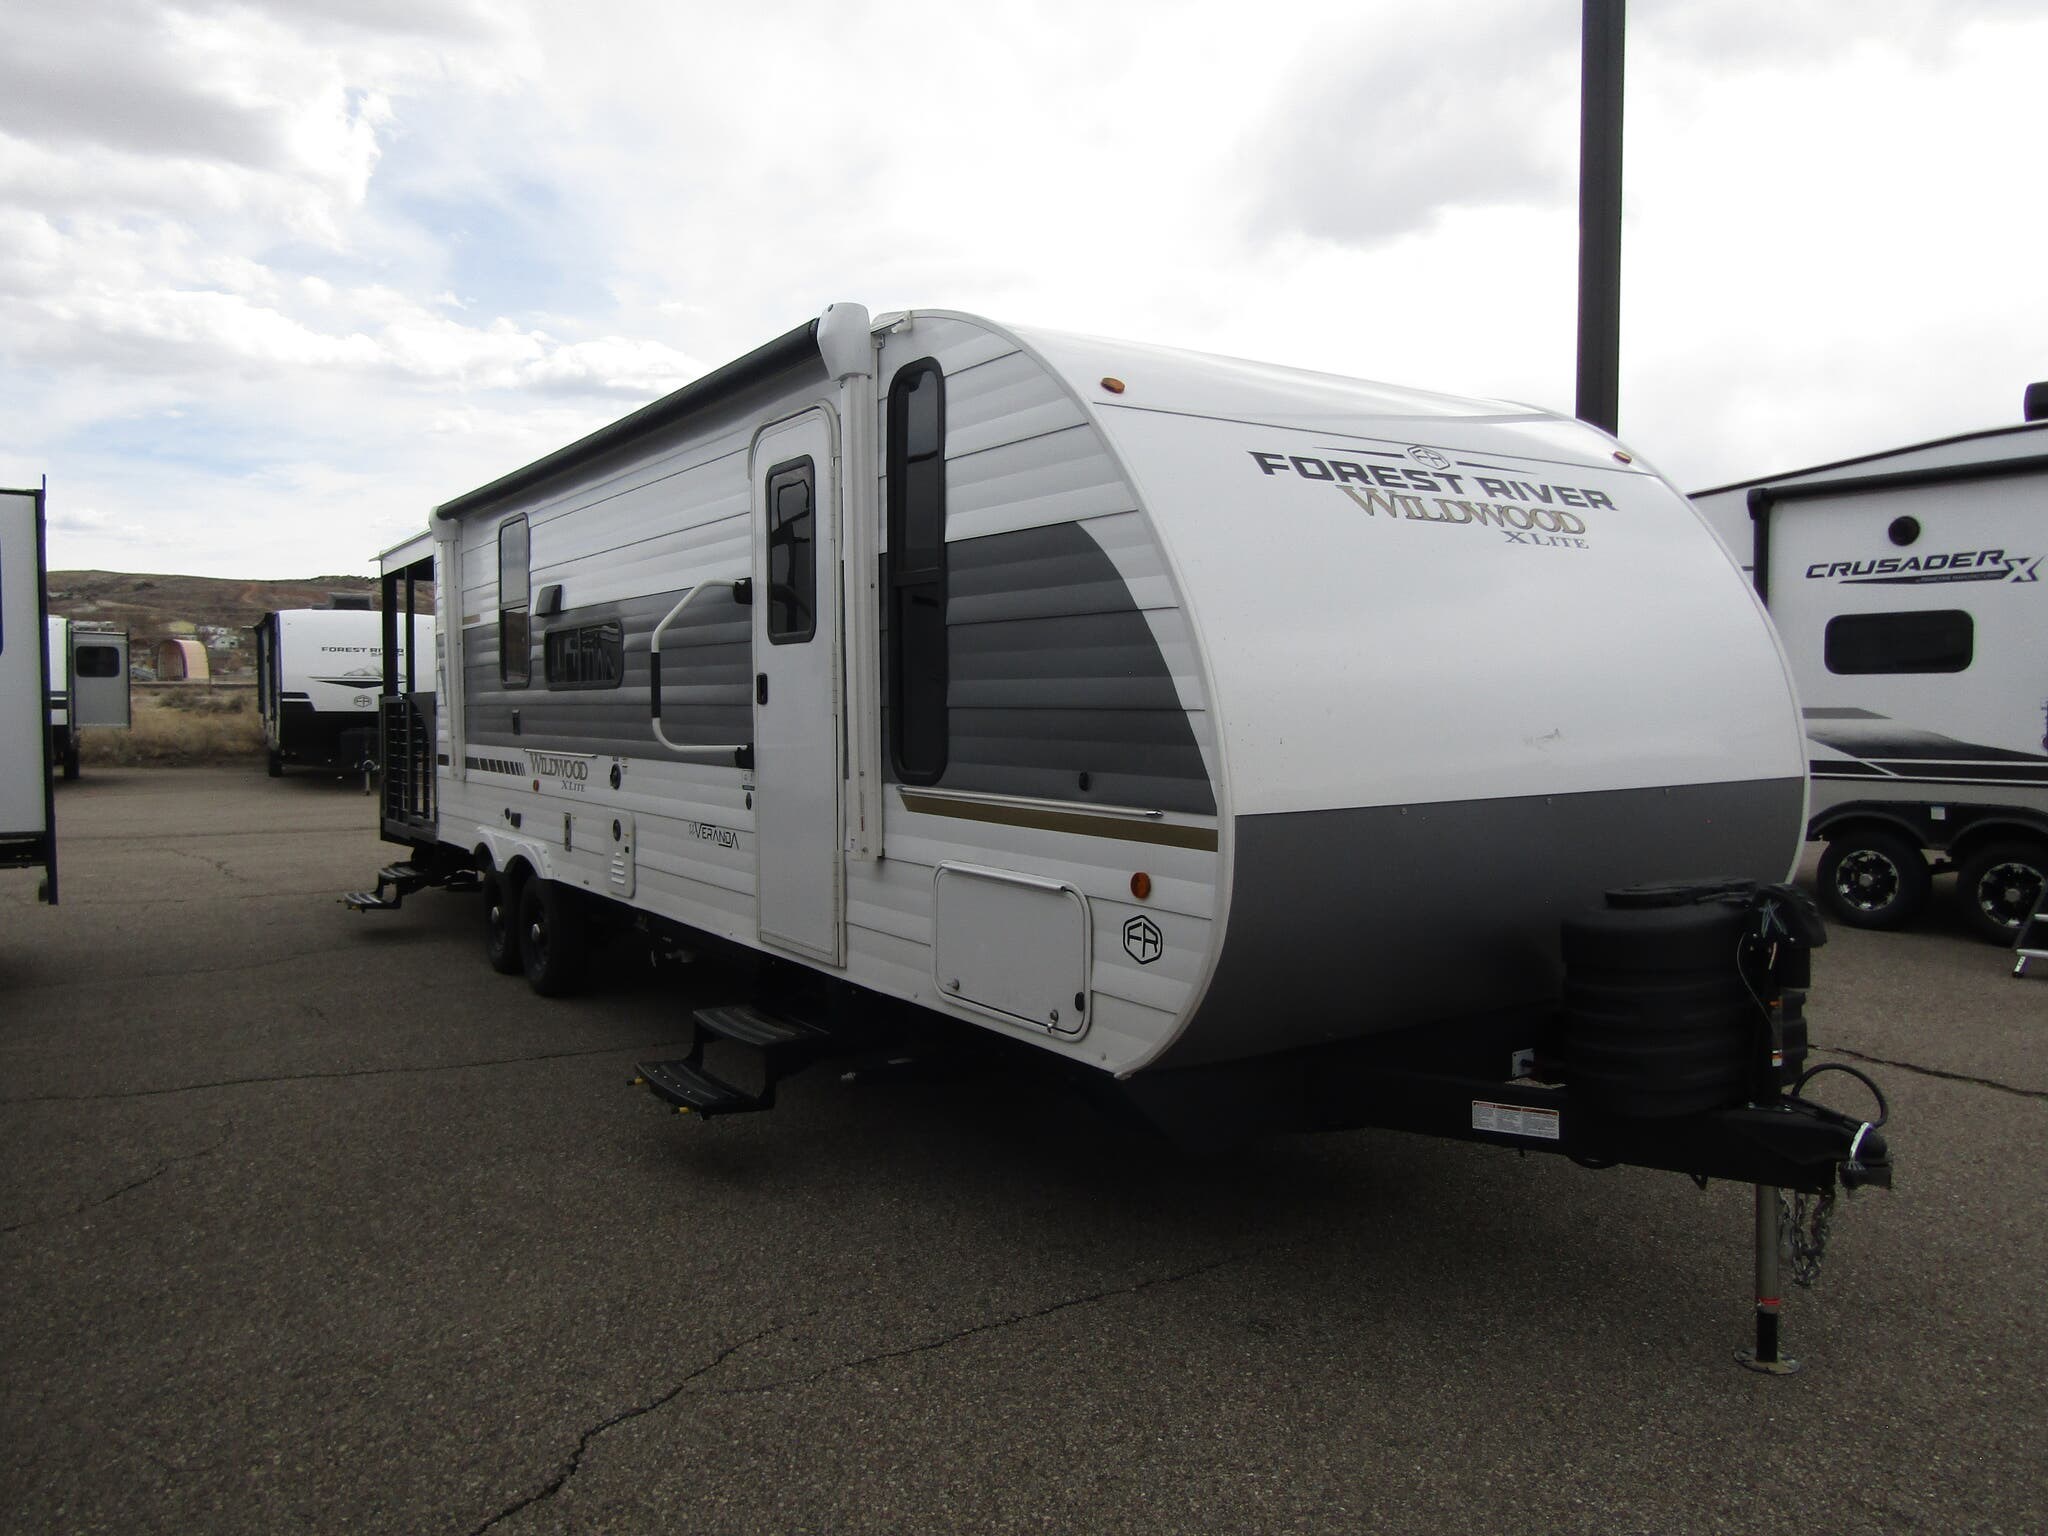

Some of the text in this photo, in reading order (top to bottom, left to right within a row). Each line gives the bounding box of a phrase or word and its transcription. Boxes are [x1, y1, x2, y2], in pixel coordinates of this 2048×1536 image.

[1247, 450, 1619, 511] FOREST RIVER
[1335, 484, 1586, 534] WILDWOOD
[1805, 549, 2047, 583] CRUSADER X
[529, 752, 588, 780] WILDWOOD
[694, 821, 739, 850] VERANDA
